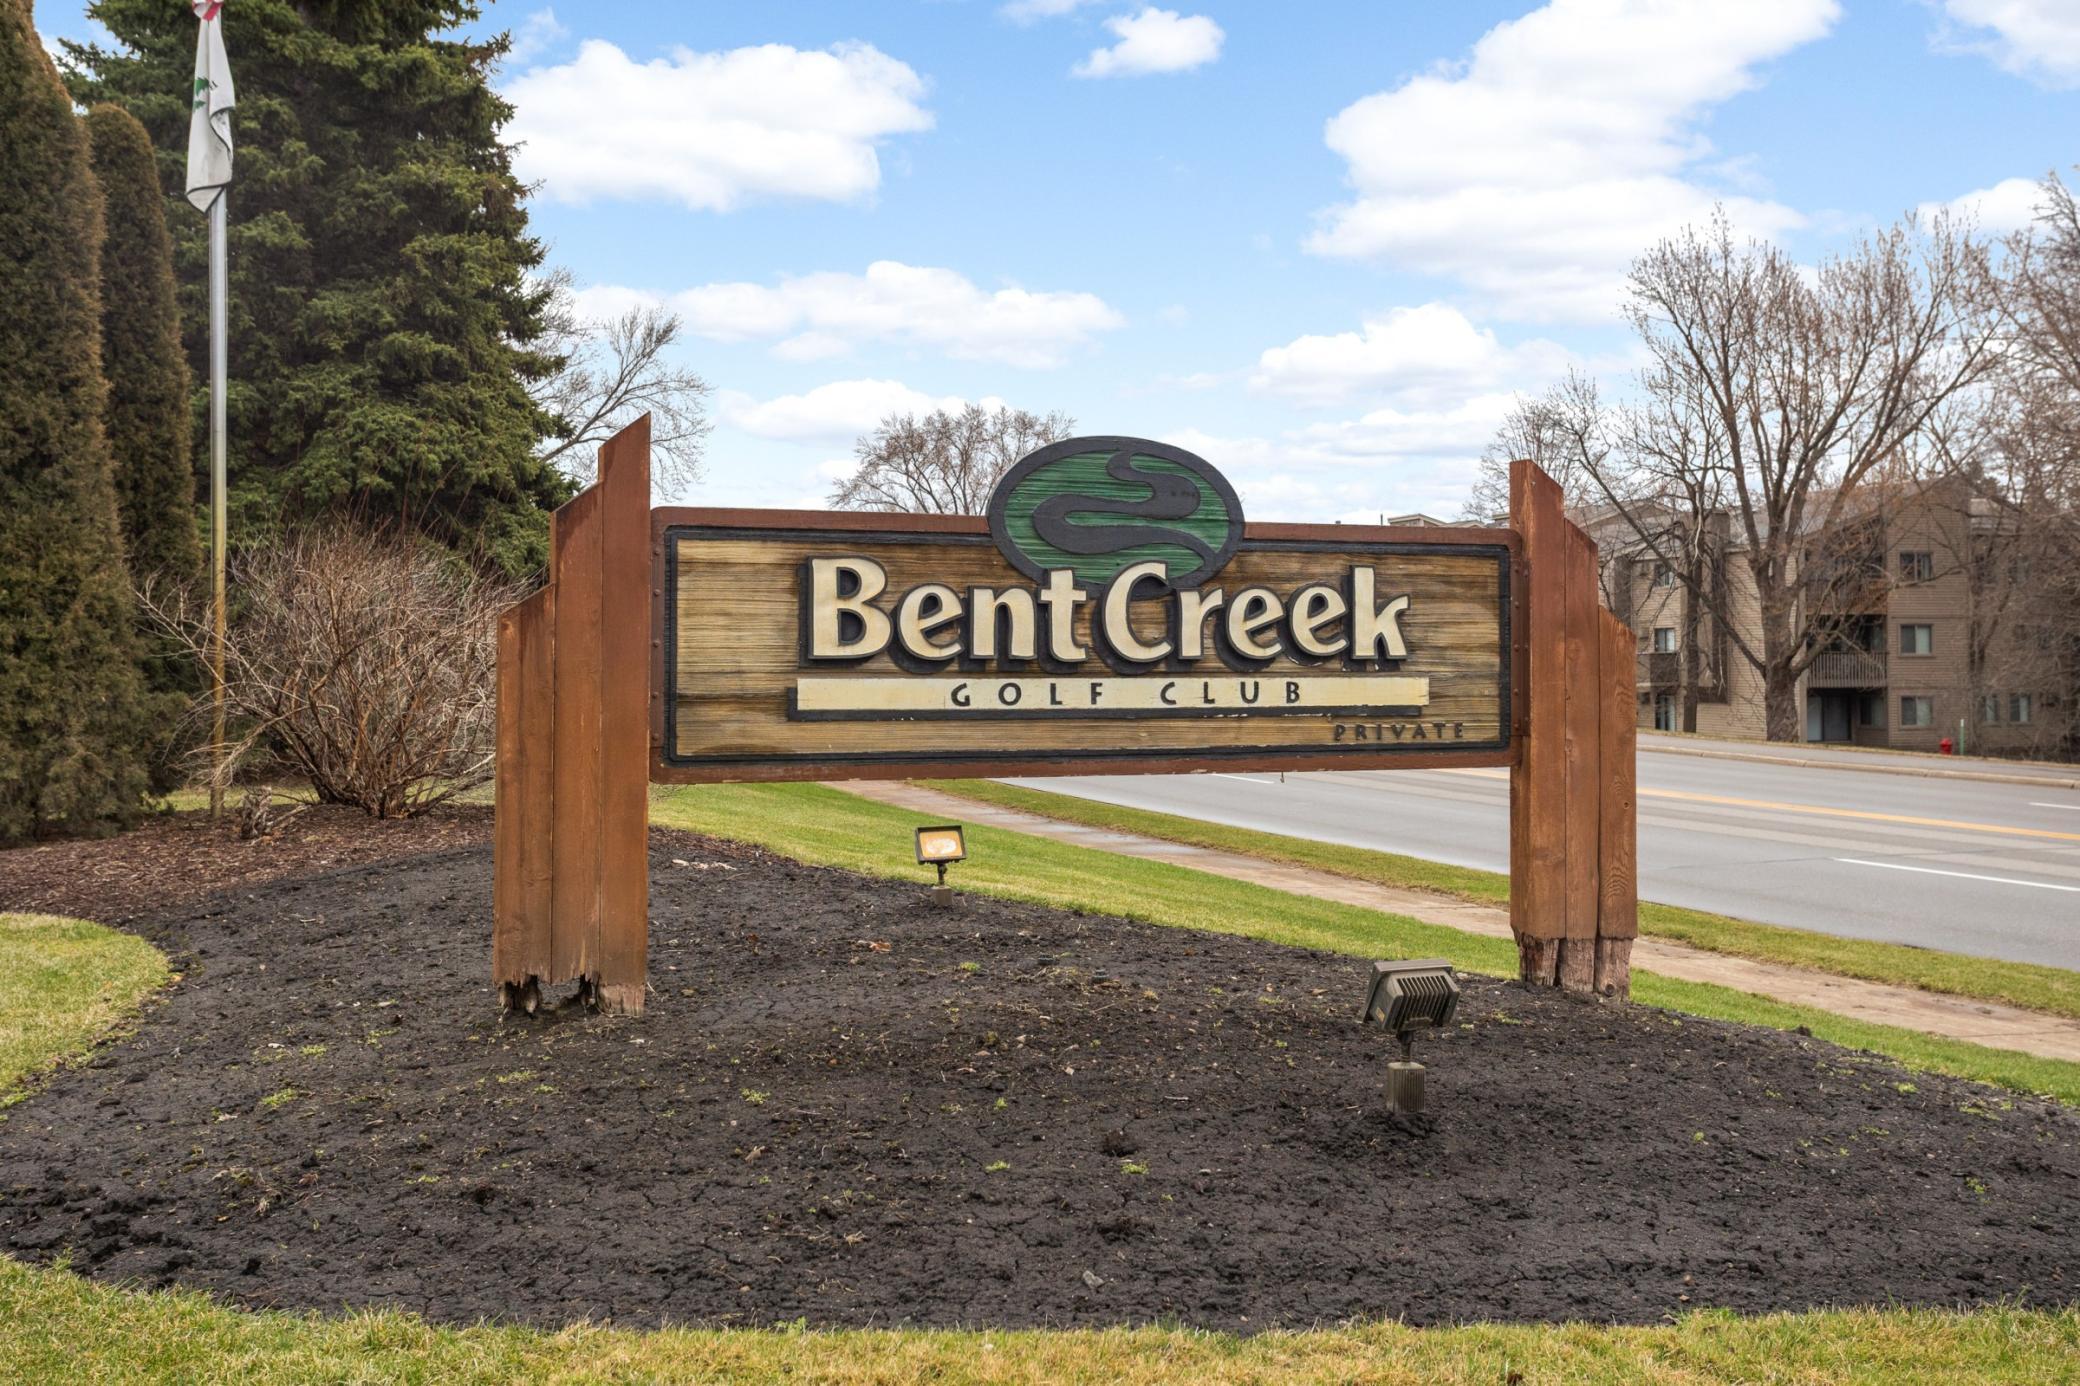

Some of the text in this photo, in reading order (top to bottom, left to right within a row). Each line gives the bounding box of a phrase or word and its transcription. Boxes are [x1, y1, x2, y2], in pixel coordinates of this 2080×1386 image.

[808, 555, 1410, 664] Bent Creek
[950, 680, 1301, 707] GOLF CLUB
[1334, 722, 1464, 742] PRIVATE
